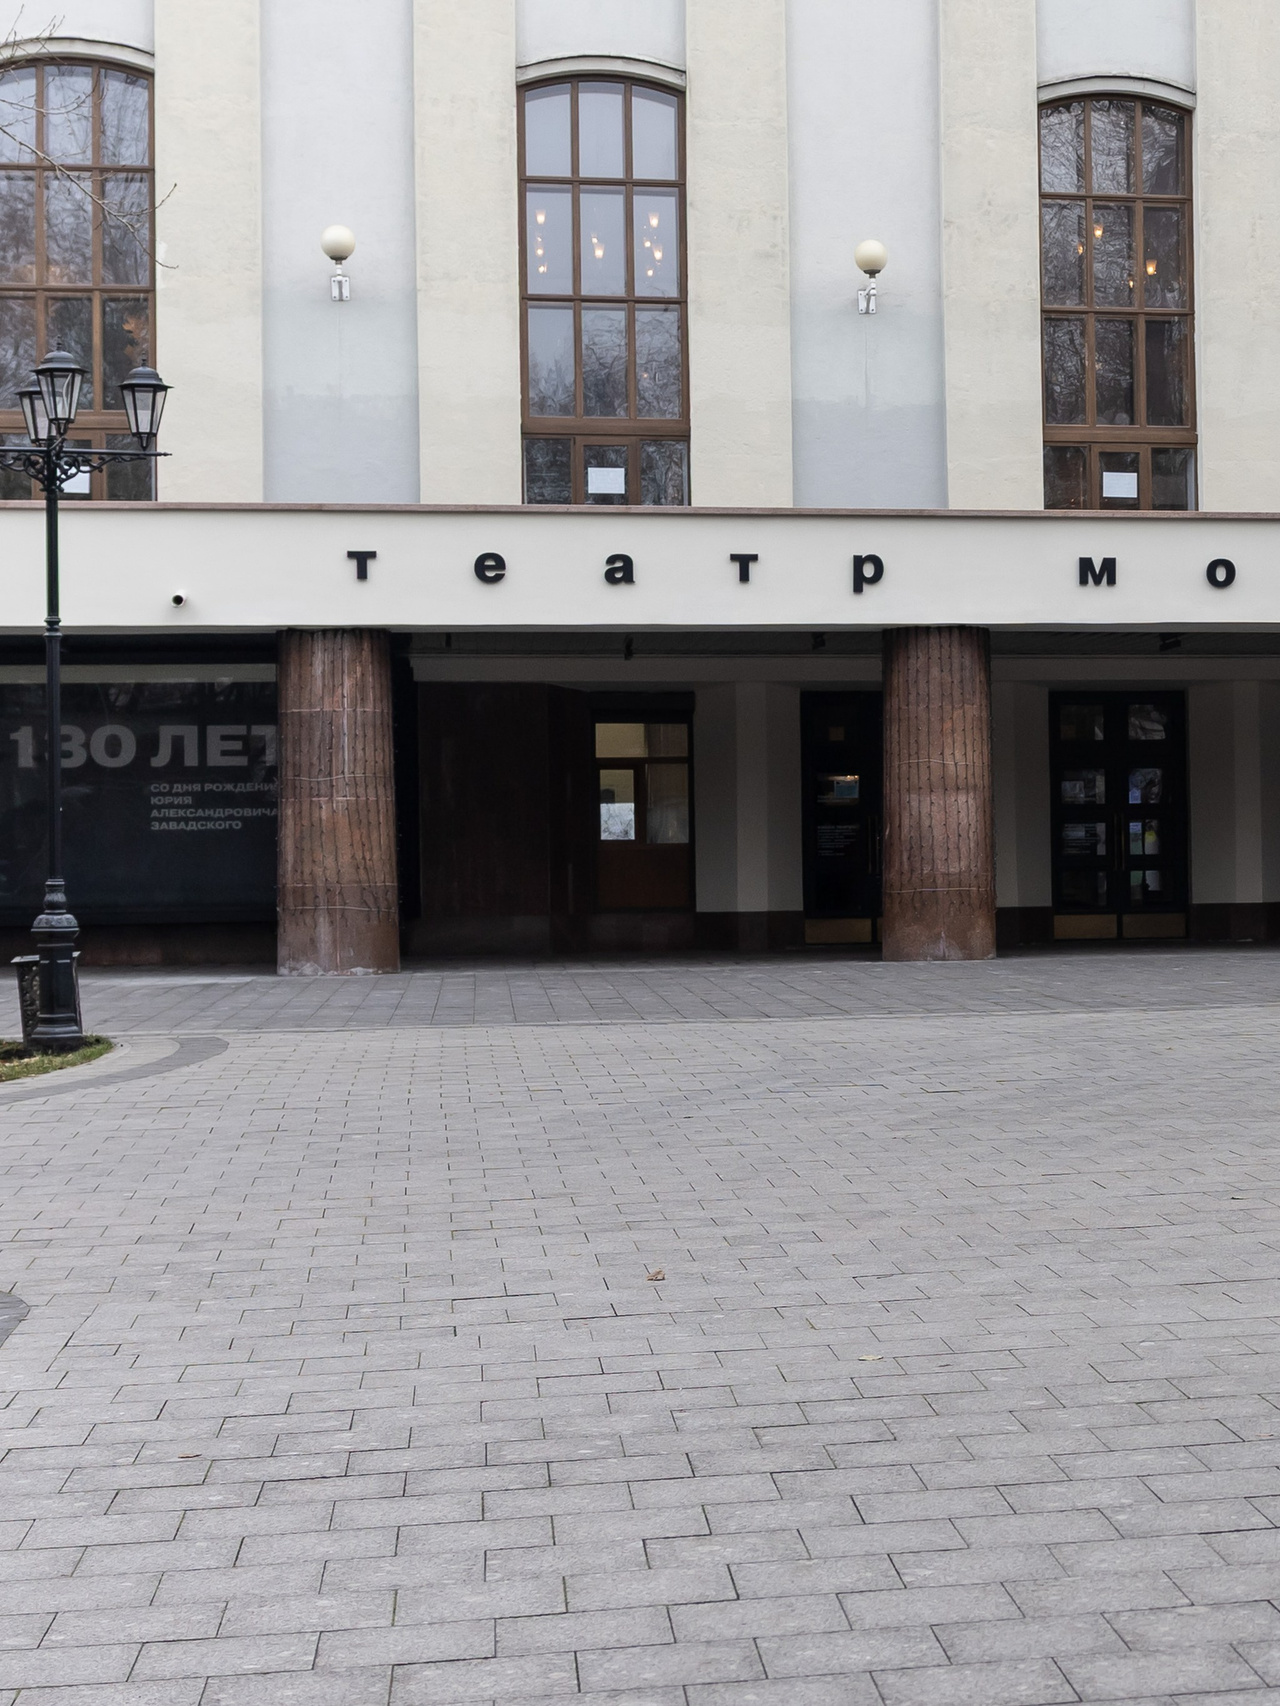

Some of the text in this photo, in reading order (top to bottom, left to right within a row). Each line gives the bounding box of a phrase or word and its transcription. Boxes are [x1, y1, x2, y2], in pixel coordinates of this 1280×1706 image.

[346, 549, 885, 596] театр
[9, 724, 278, 769] 130 ЛЕТ
[150, 782, 170, 793] СО
[172, 782, 202, 795] ДНЯ
[150, 795, 193, 806] ЮРИЯ
[150, 819, 242, 831] ЗАВАДСКОГО
